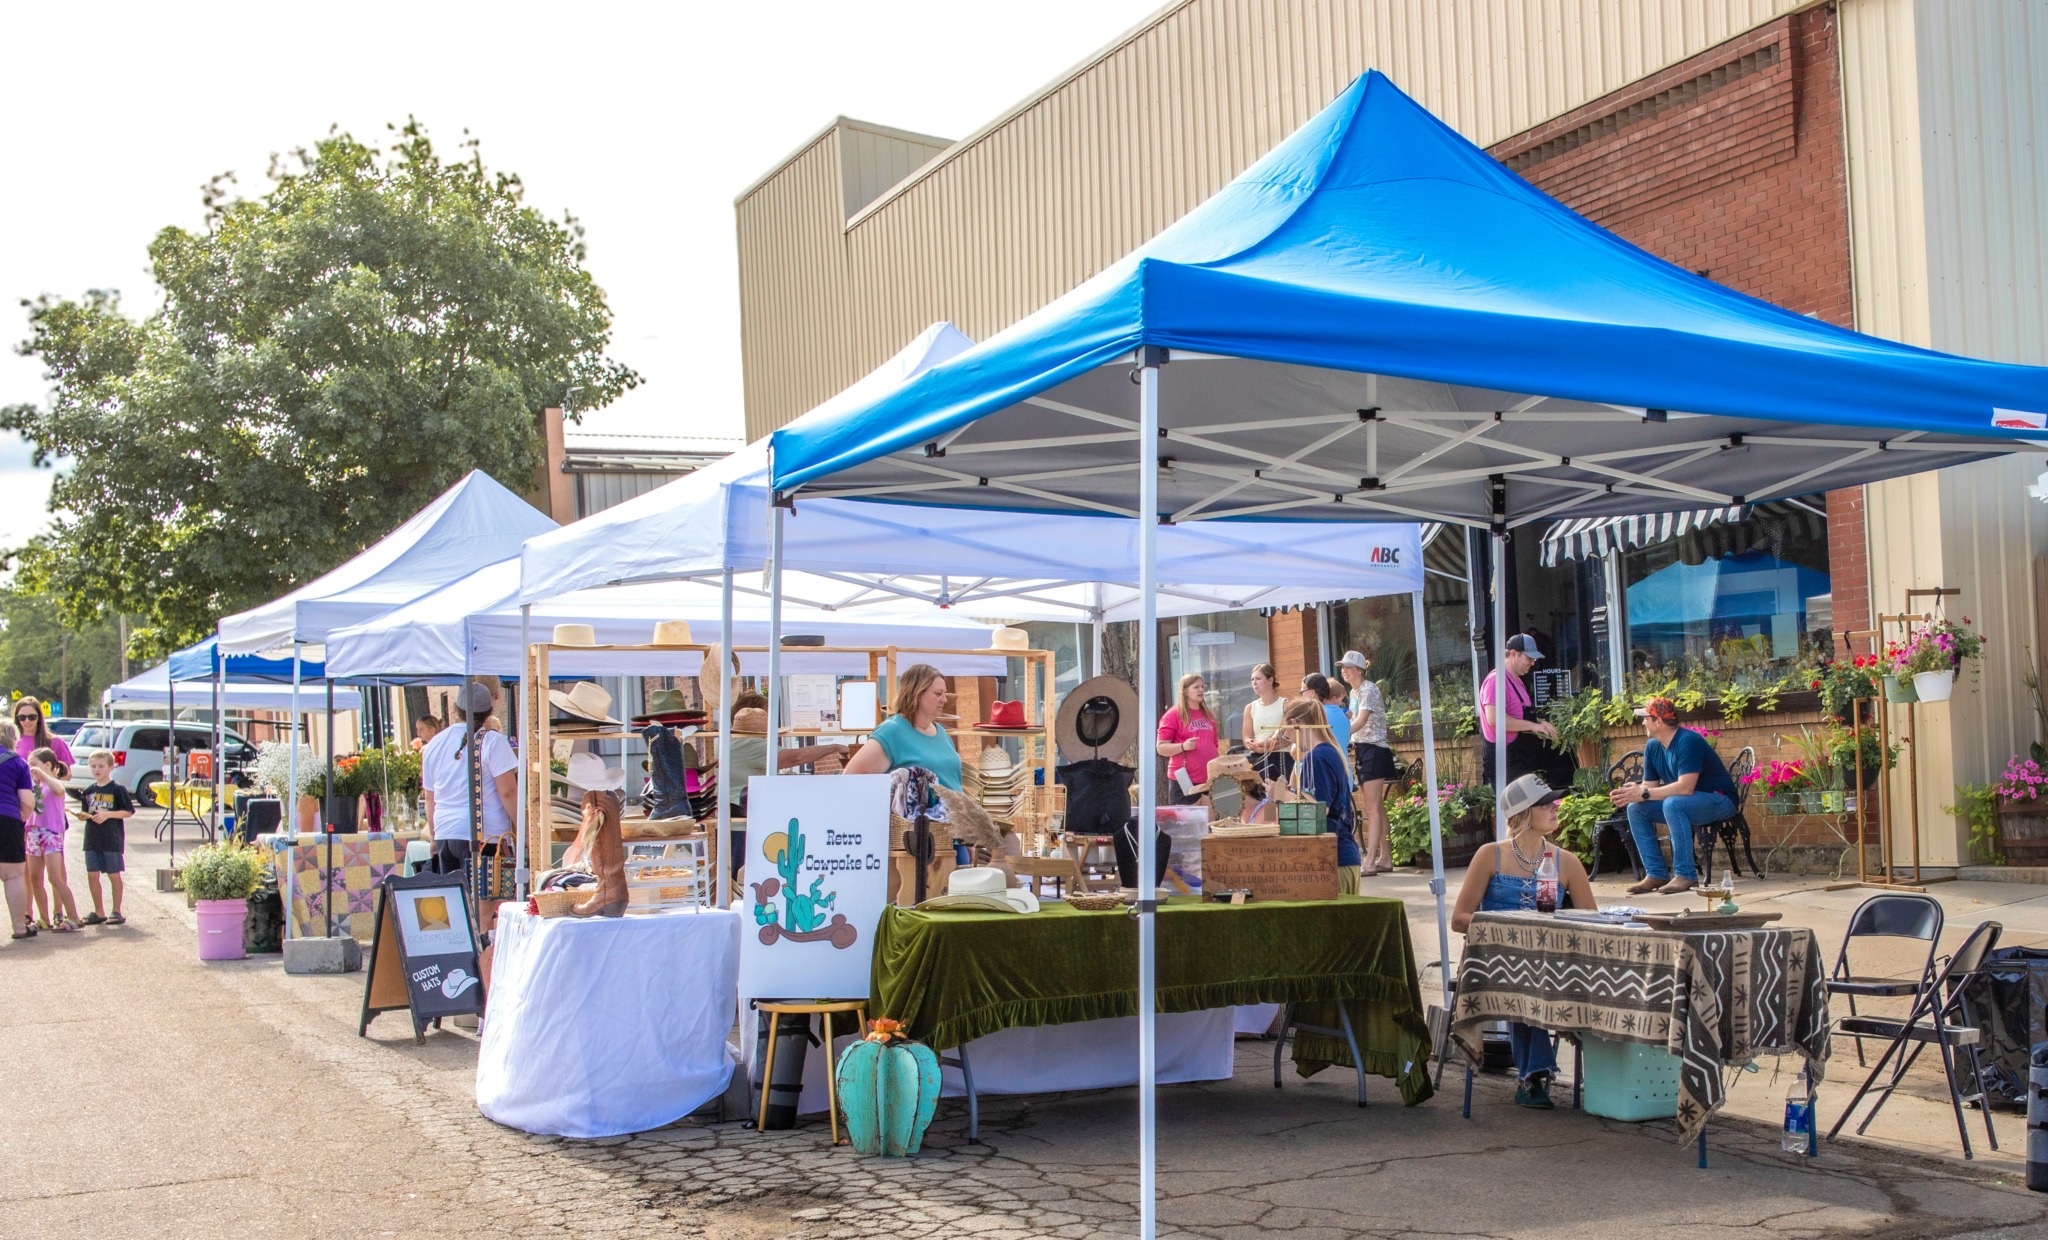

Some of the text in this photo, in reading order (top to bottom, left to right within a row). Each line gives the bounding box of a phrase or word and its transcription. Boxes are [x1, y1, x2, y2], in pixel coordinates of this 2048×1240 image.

[1370, 547, 1400, 564] ABC
[826, 829, 862, 846] Retro
[805, 853, 881, 875] Cowpoke Co
[408, 931, 467, 944] GOLDEN ROAD
[412, 963, 441, 982] CUSTOM
[421, 976, 442, 992] HATS
